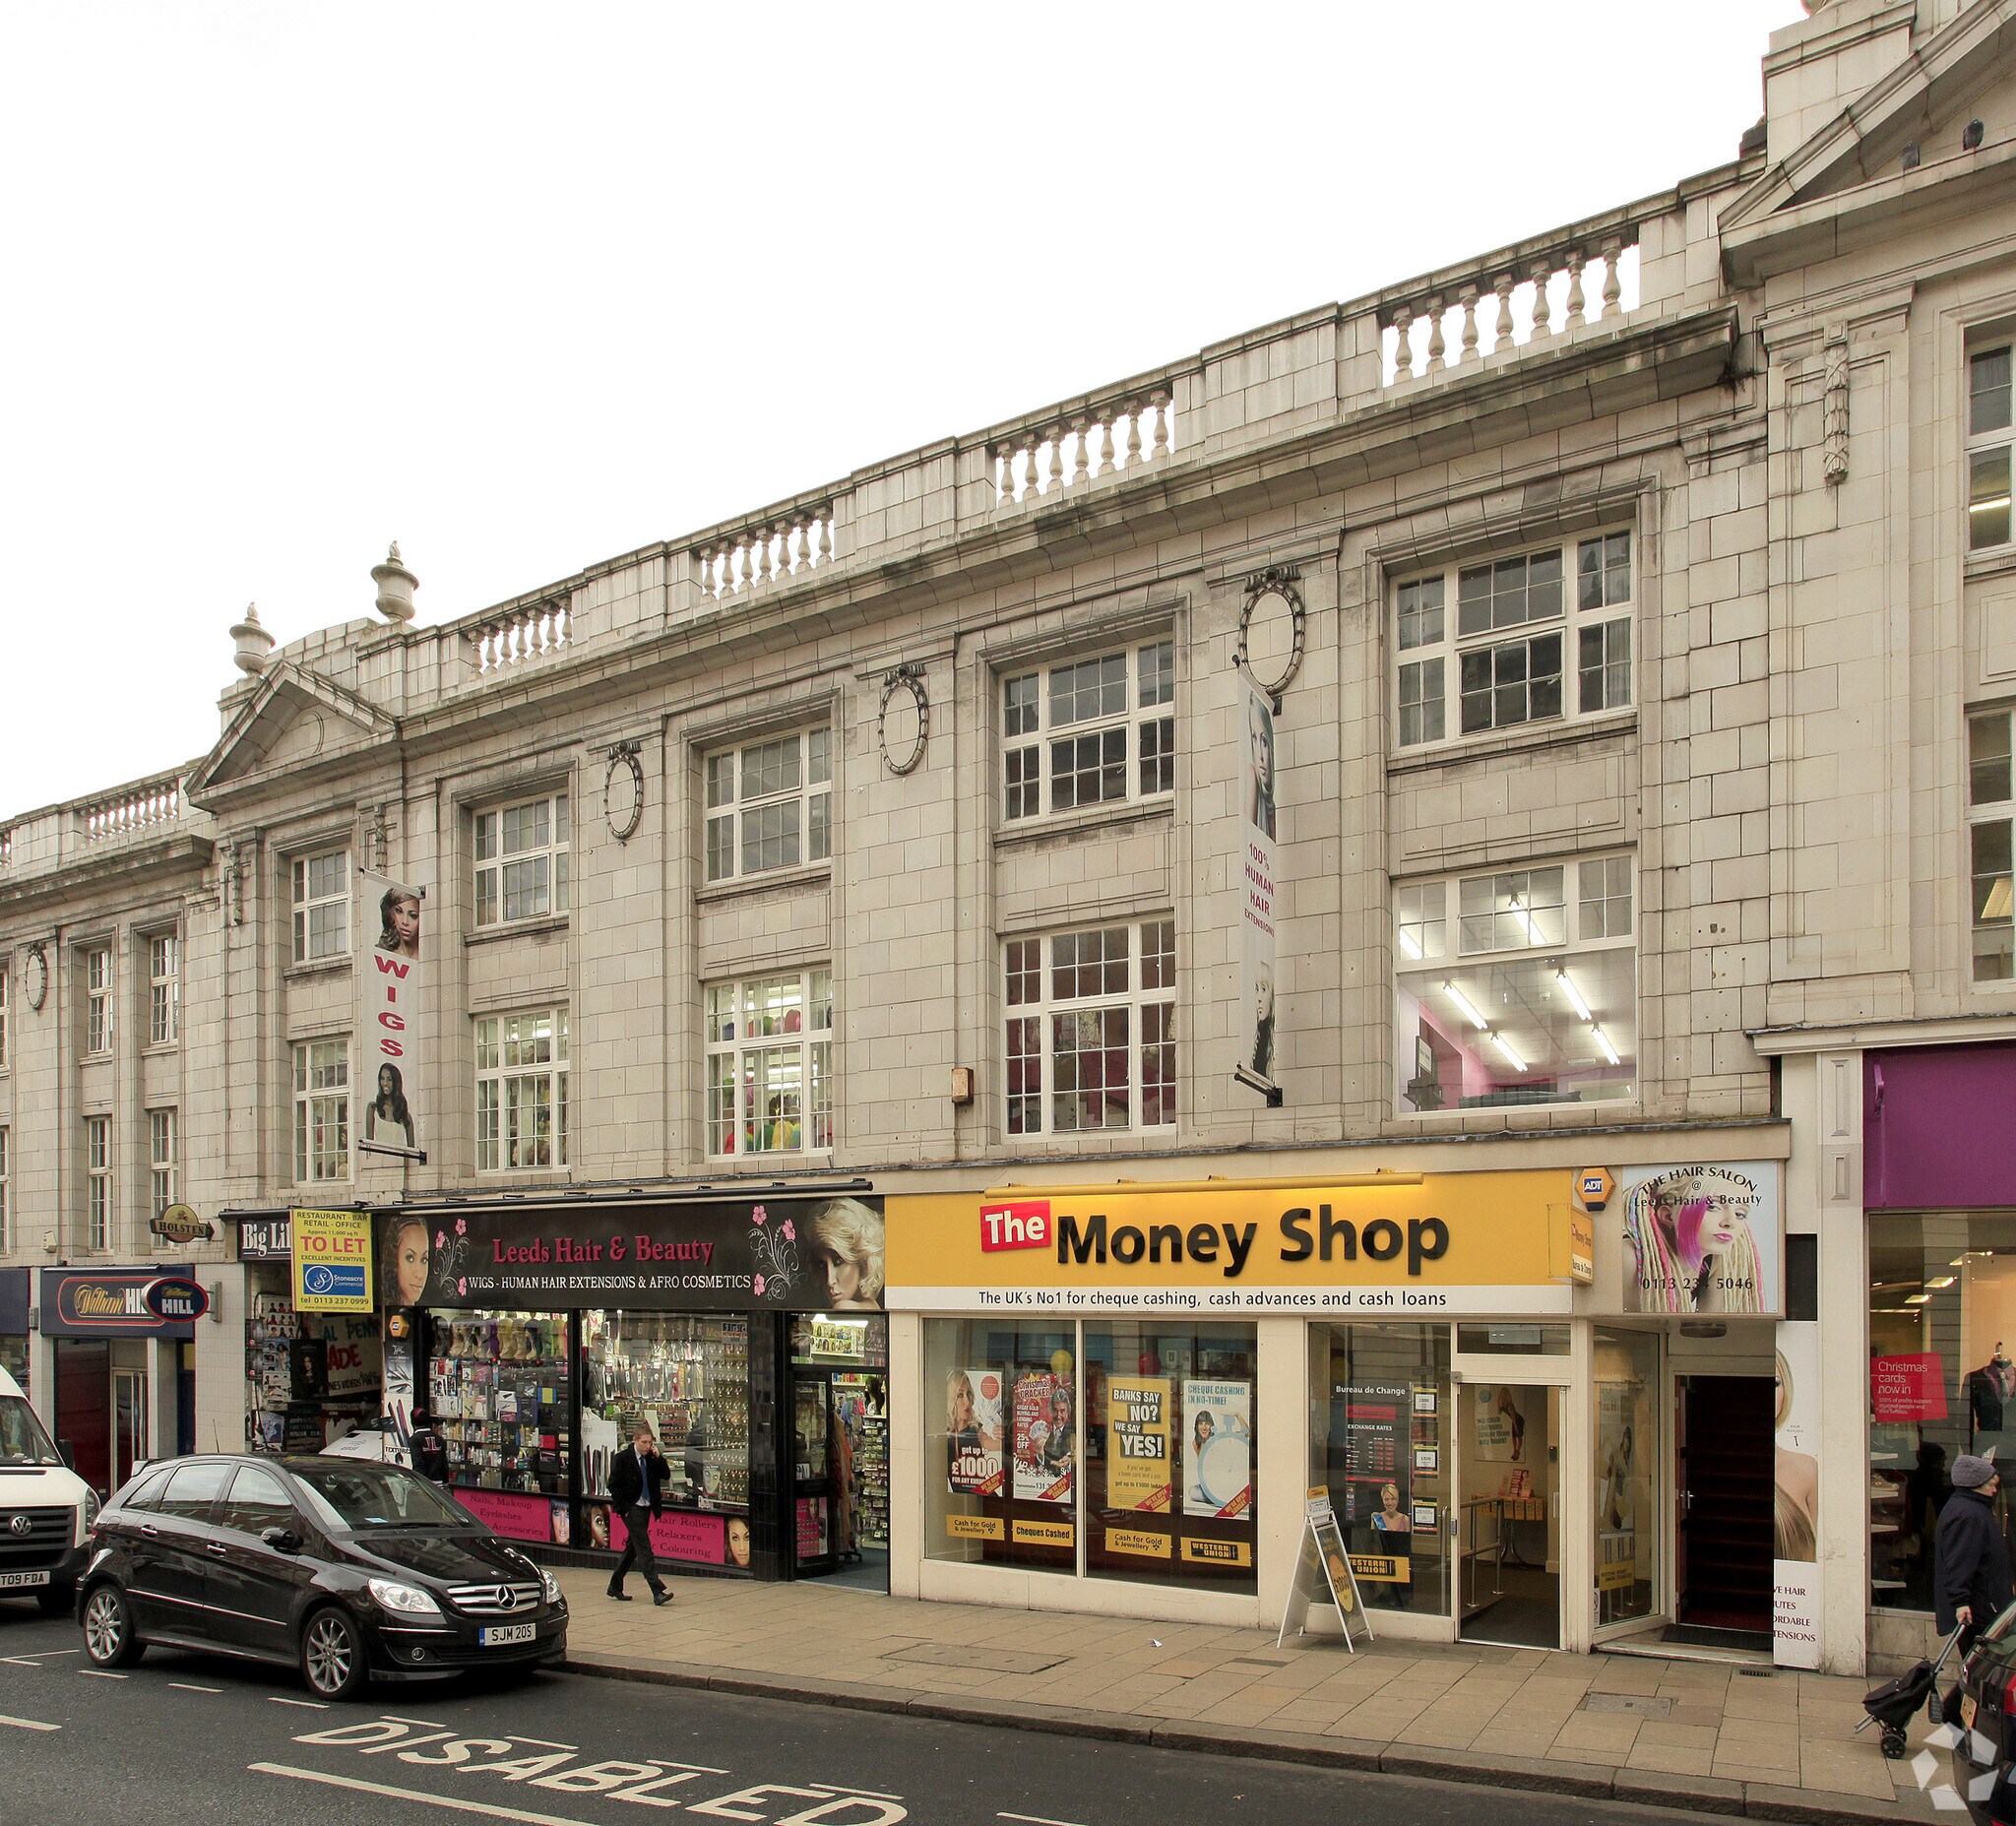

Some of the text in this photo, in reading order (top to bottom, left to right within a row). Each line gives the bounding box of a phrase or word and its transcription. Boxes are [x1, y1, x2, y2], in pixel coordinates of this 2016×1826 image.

[1248, 843, 1270, 871] 100%
[1245, 862, 1274, 897] HUMAN
[1250, 890, 1270, 916] HAIR
[1244, 908, 1275, 937] EXTENSIONS
[374, 955, 410, 1057] WIGS
[1584, 1179, 1603, 1191] ADT
[1641, 1165, 1758, 1195] THE HAIR SALON
[1691, 1181, 1702, 1191] @
[1674, 1196, 1700, 1206] Hair
[1706, 1195, 1715, 1205] &
[1720, 1194, 1763, 1207] Beauty
[296, 1211, 346, 1221] RESTAURANT
[158, 1222, 205, 1235] HOLSTEN
[242, 1224, 269, 1257] Big
[300, 1235, 365, 1253] TO LET
[985, 1204, 1449, 1278] The Money Shop
[492, 1235, 714, 1266] Leeds Hair & Beauty
[469, 1275, 751, 1289] WIGS HUMAN HAIR EXTENSIONS & AFRO COSMETICS
[1642, 1278, 1676, 1290] 0113
[1717, 1278, 1753, 1290] 5046
[161, 1286, 193, 1297] William
[74, 1284, 125, 1315] William
[978, 1291, 1001, 1304] The
[1037, 1291, 1061, 1304] No1
[1066, 1291, 1086, 1304] for
[1090, 1291, 1139, 1307] cheque
[1143, 1291, 1202, 1307] cashing,
[1209, 1291, 1240, 1305] cash
[1245, 1291, 1316, 1305] advances
[1322, 1291, 1352, 1305] and
[1358, 1291, 1394, 1305] cash
[1402, 1291, 1446, 1306] loans
[161, 1298, 195, 1314] HILL
[1878, 1360, 1927, 1373] Christmas
[1018, 1379, 1051, 1390] Christmas
[1878, 1373, 1907, 1383] cards
[1187, 1385, 1245, 1396] CHEQUE CASHING
[1376, 1387, 1406, 1397] Change
[1877, 1384, 1912, 1394] now in
[1113, 1389, 1160, 1403] BANKS SAY
[1187, 1395, 1227, 1406] IN NO-TIME!
[1130, 1405, 1159, 1421] NO?
[1114, 1421, 1141, 1433] WE SAY
[1120, 1434, 1163, 1457] YES!
[497, 1496, 533, 1510] Makeup
[479, 1508, 523, 1521] Eyelashes
[492, 1523, 544, 1536] Accessories
[681, 1517, 718, 1530] Rollers
[657, 1529, 702, 1543] Relaxers
[1016, 1526, 1070, 1539] Cheques Cashed
[1114, 1533, 1163, 1545] Cash for Gold
[660, 1543, 711, 1558] Colouring
[1120, 1541, 1149, 1551] Jewellery
[1192, 1543, 1229, 1551] WESTERN
[25, 1572, 44, 1584] FDA
[1784, 1586, 1806, 1596] HAIR
[491, 1627, 514, 1641] SJM
[291, 1720, 909, 1826] DISABLED
